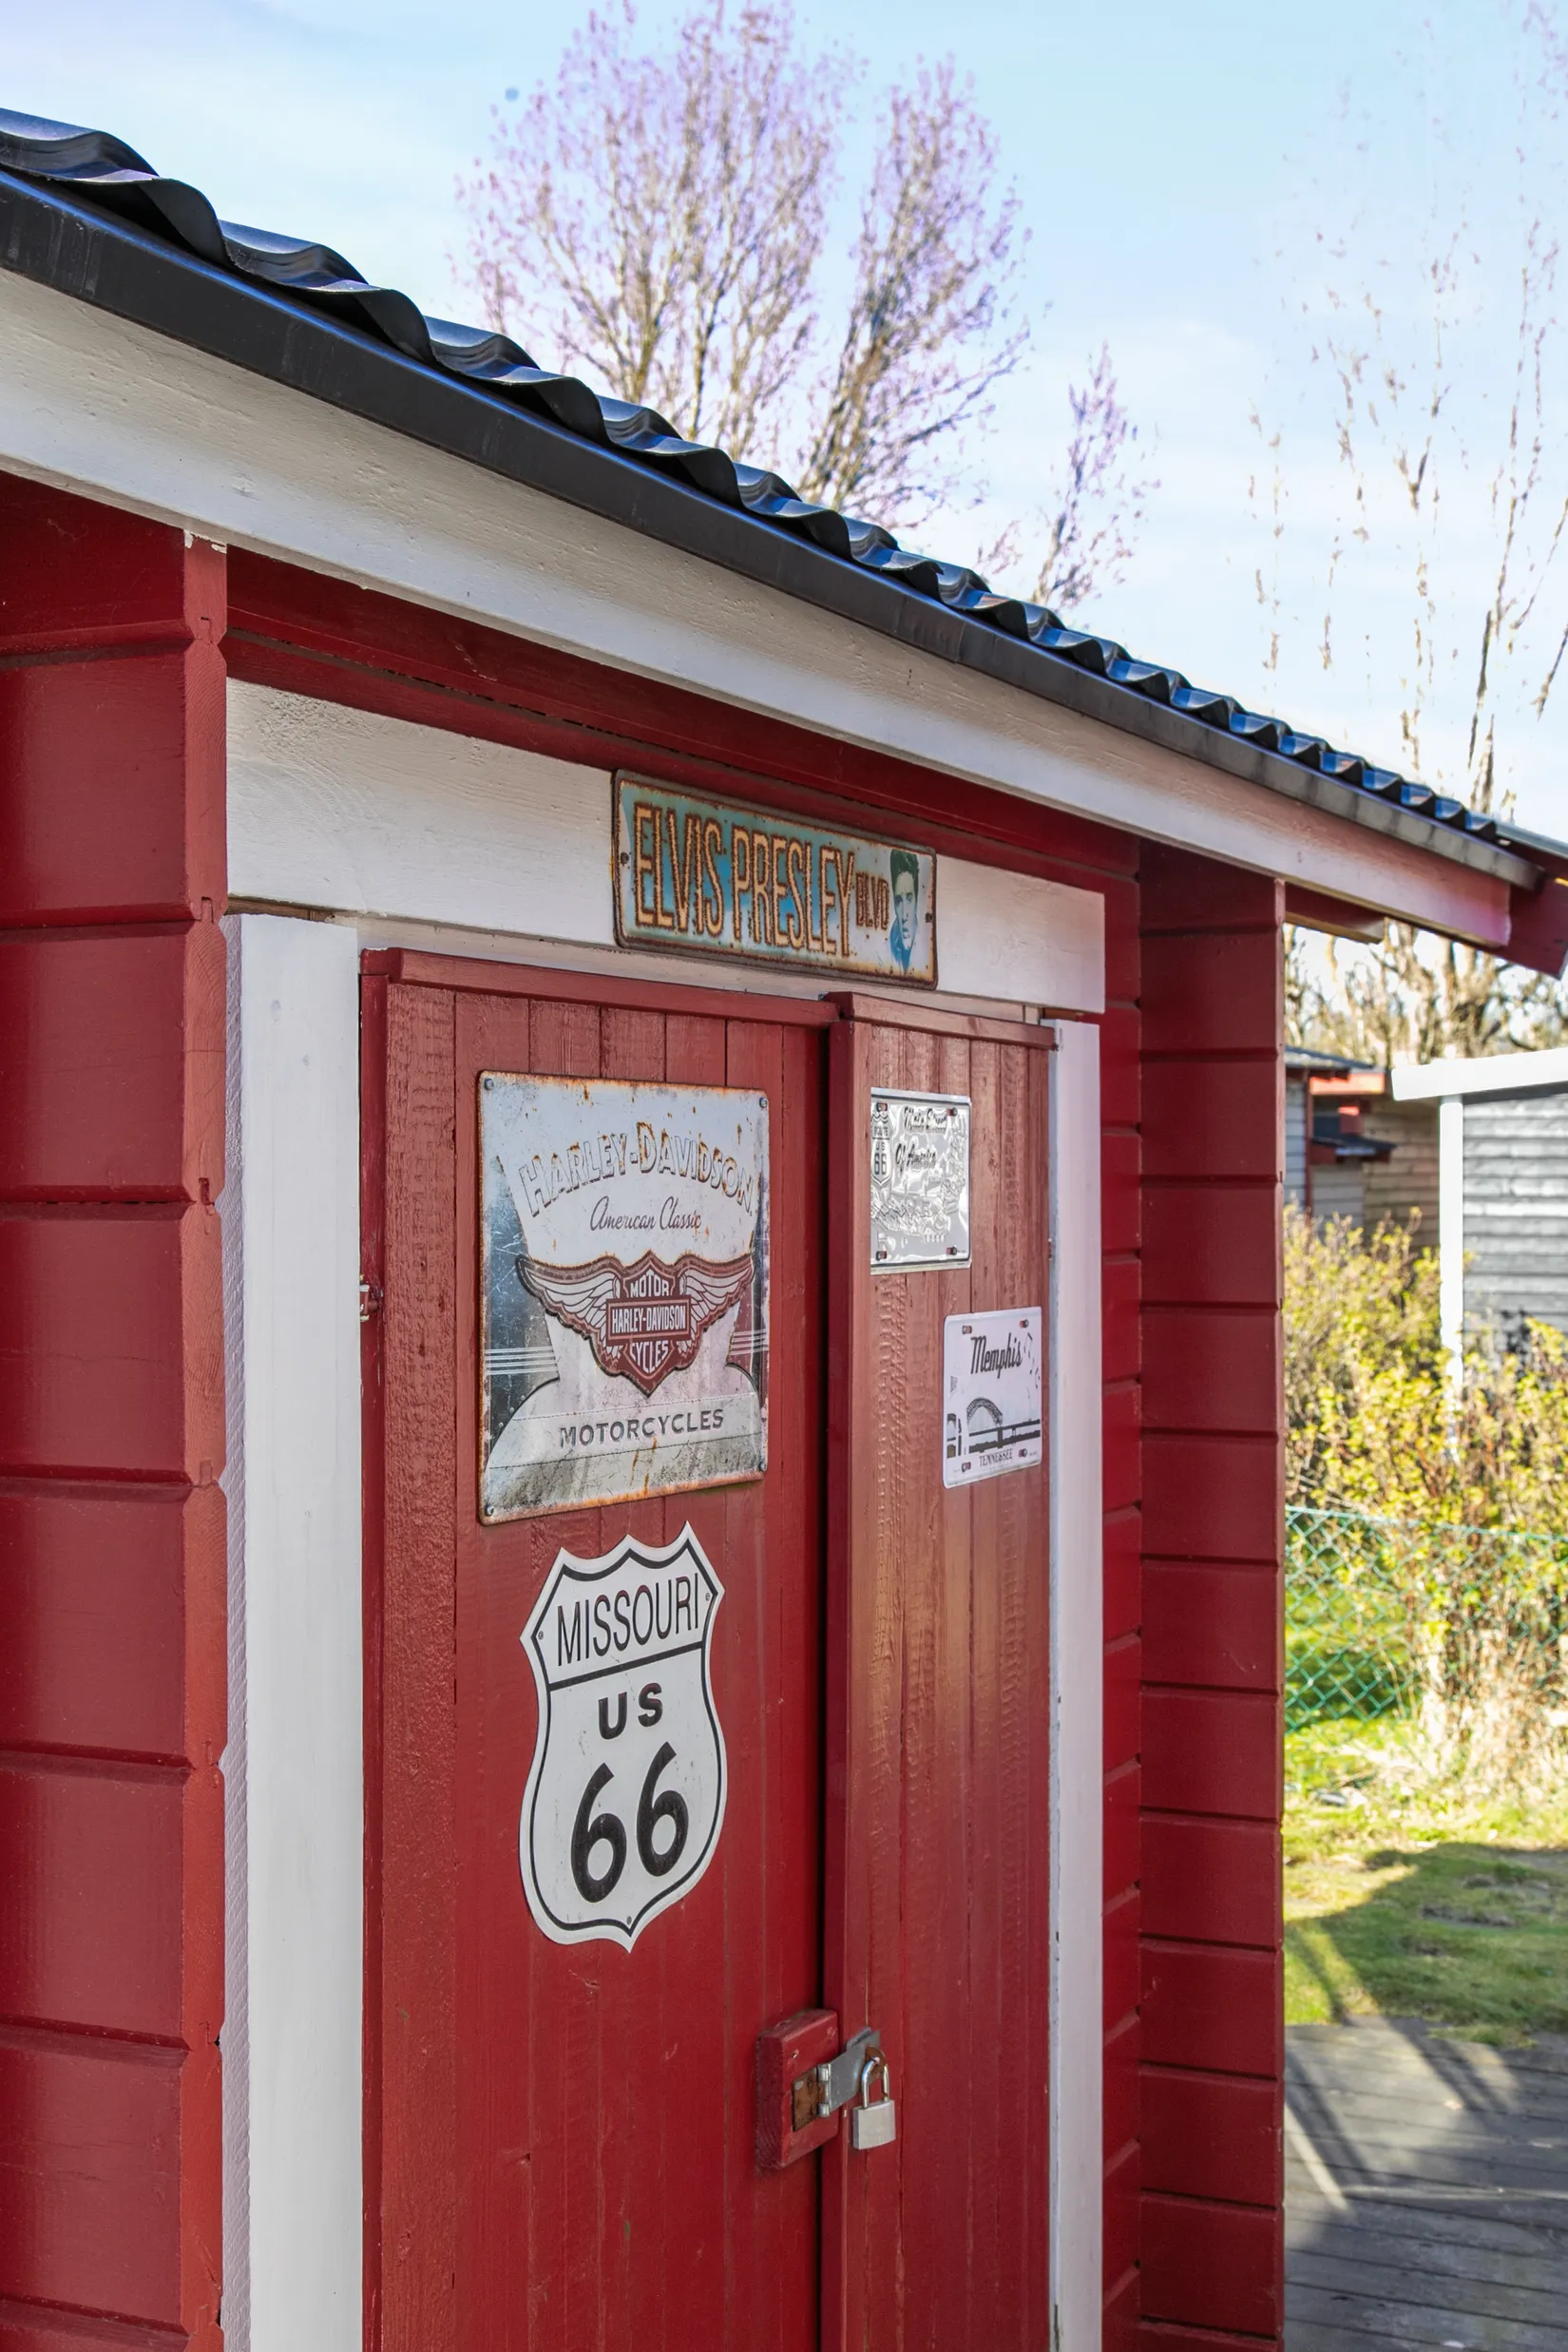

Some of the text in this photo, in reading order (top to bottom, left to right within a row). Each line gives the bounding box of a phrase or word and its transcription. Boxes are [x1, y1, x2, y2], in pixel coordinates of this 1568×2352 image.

[633, 800, 889, 958] ELVIS PRESLEY BLVD
[873, 1153, 888, 1176] 66
[589, 1195, 702, 1232] American Classic
[630, 1269, 669, 1298] MOTOR
[612, 1305, 686, 1334] HARLEY-DAVIDSON
[629, 1340, 669, 1374] CYCLES
[970, 1332, 1023, 1380] Memphis
[559, 1408, 724, 1448] MOTORCYCLES
[979, 1448, 1014, 1468] TENNESSEE
[557, 1572, 699, 1667] MISSOURI
[598, 1682, 663, 1740] US
[570, 1741, 689, 1903] 66
